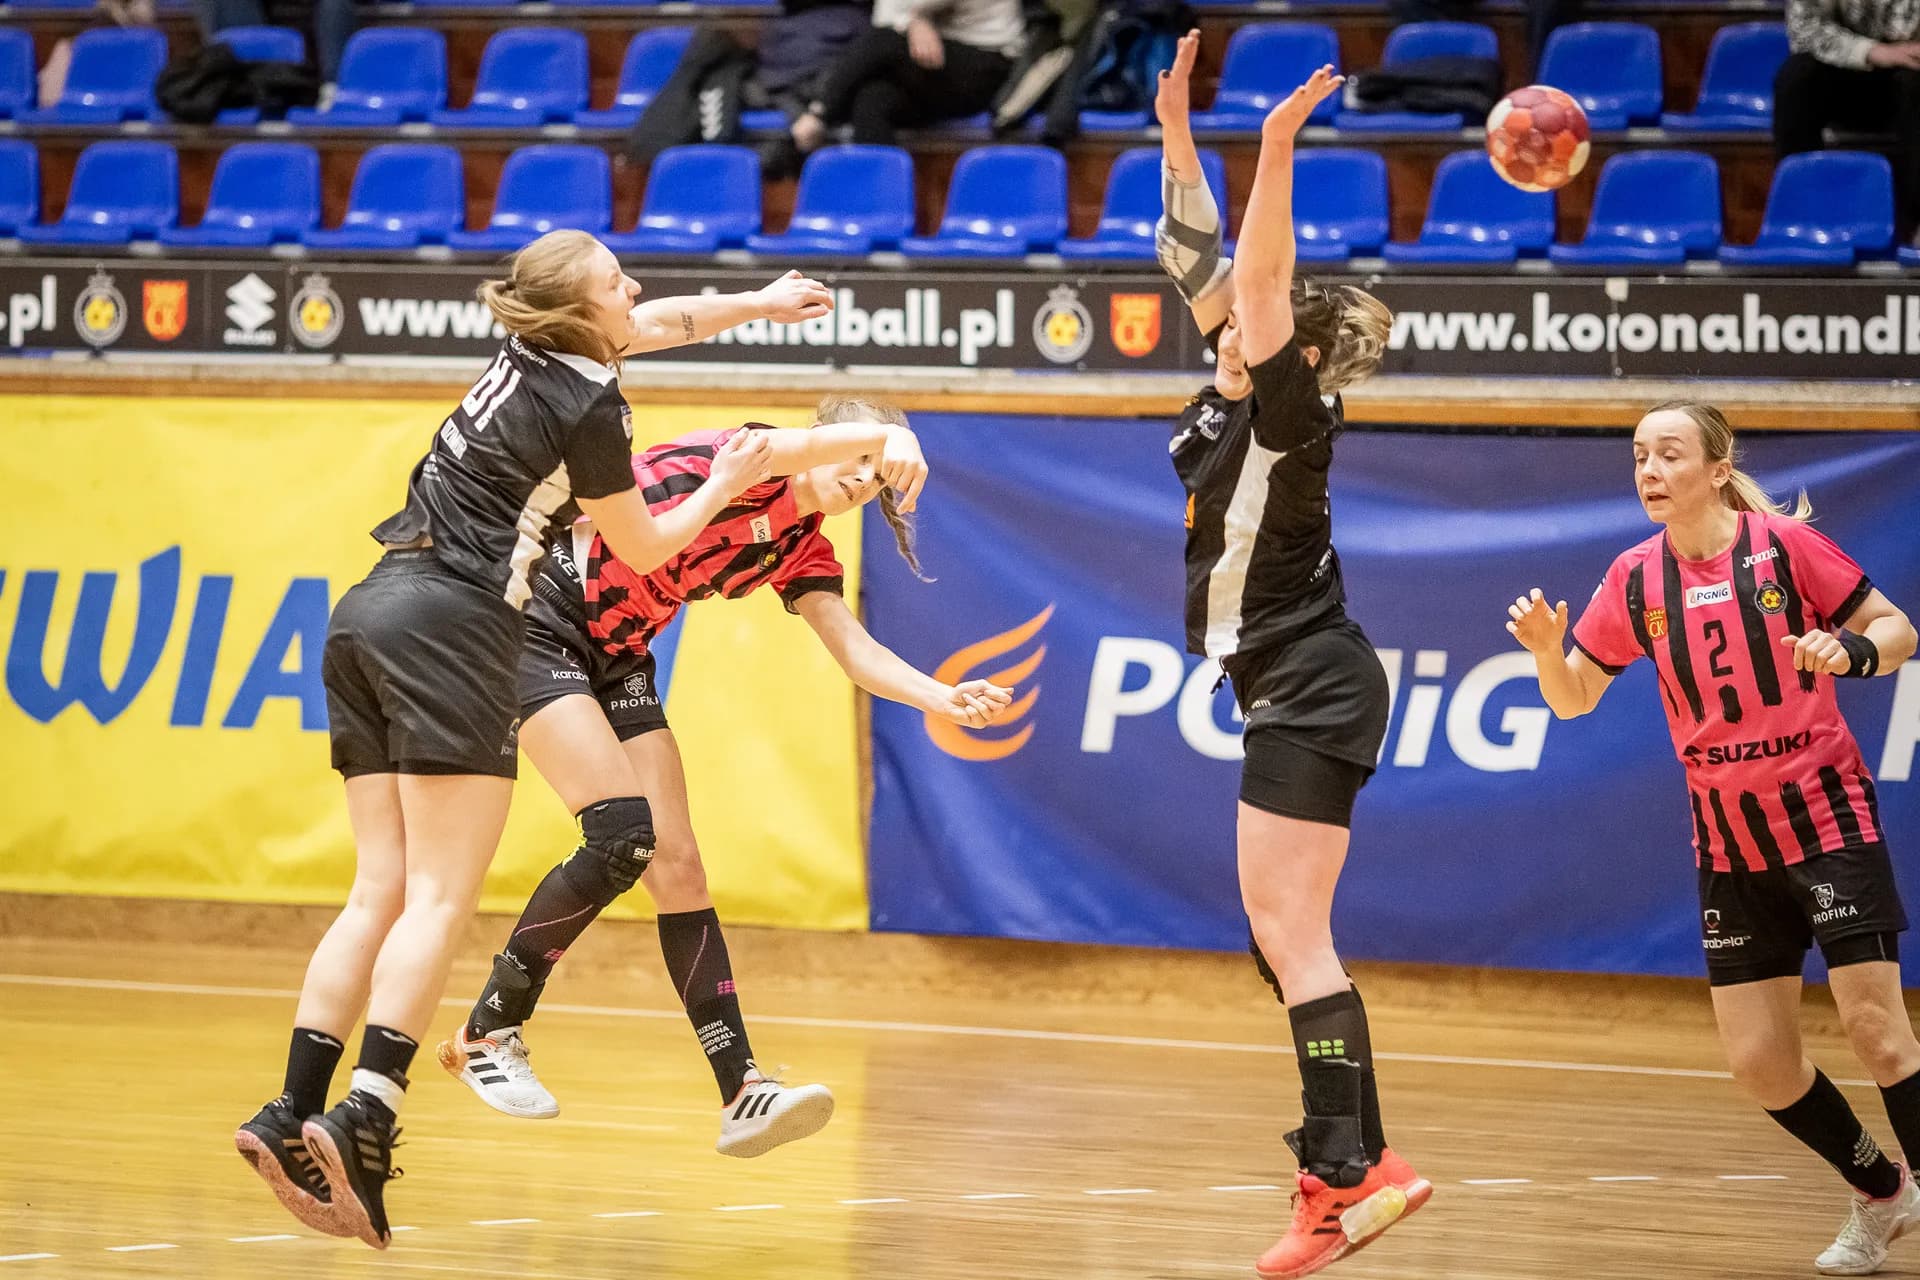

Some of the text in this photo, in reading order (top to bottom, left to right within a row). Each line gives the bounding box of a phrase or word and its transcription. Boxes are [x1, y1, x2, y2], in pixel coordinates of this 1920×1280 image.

[1696, 587, 1729, 601] PGNiG
[1648, 619, 1665, 639] CK
[1703, 619, 1734, 677] 2
[1080, 636, 1551, 772] PGiG
[1707, 730, 1811, 765] SUZUKI
[1812, 904, 1859, 925] PROFIKA
